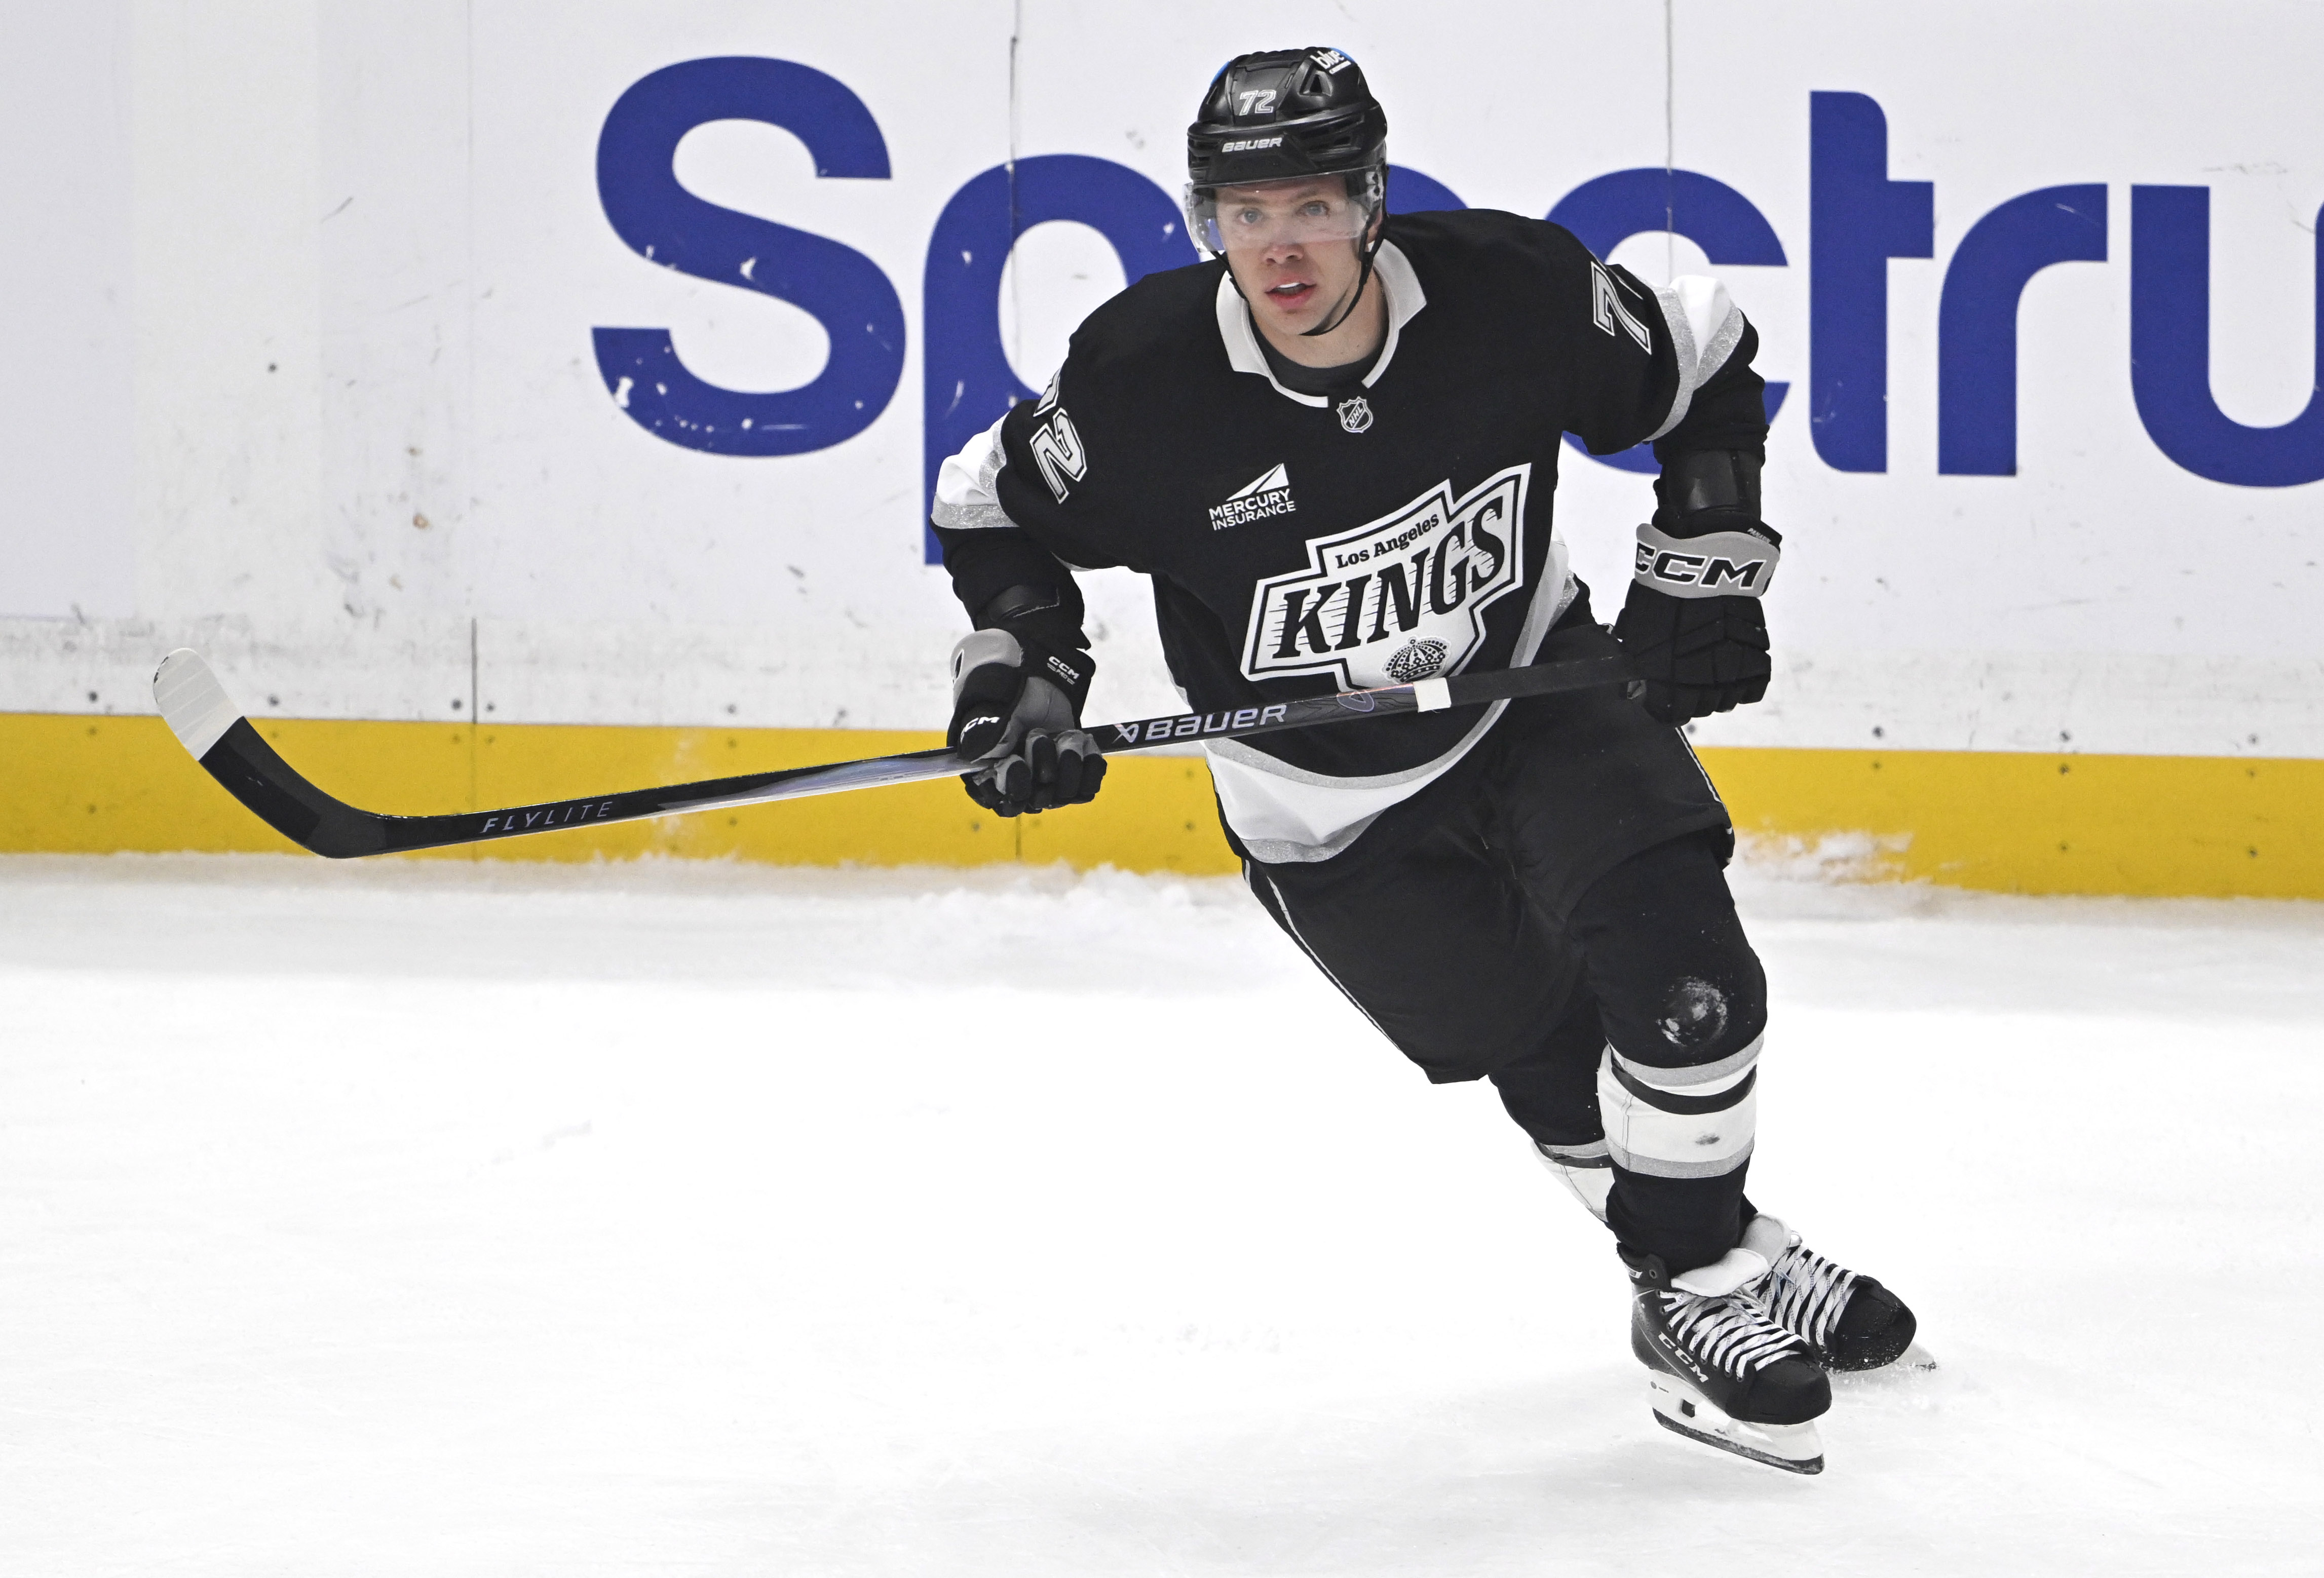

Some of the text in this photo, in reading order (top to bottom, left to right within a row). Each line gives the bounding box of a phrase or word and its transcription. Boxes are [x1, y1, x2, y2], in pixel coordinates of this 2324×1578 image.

[1309, 50, 1345, 70] blue
[1239, 89, 1276, 116] 72
[593, 56, 2324, 565] Spctru
[1348, 406, 1364, 428] NHL
[1208, 488, 1290, 521] MERCURY
[1211, 501, 1297, 531] INSURANCE
[1335, 513, 1439, 569] Los Angeles
[1270, 495, 1506, 660] KINGS
[1635, 540, 1767, 591] CCM
[1048, 656, 1080, 679] CCM
[479, 801, 613, 834] FLYLITE
[1658, 1330, 1709, 1383] CCM
